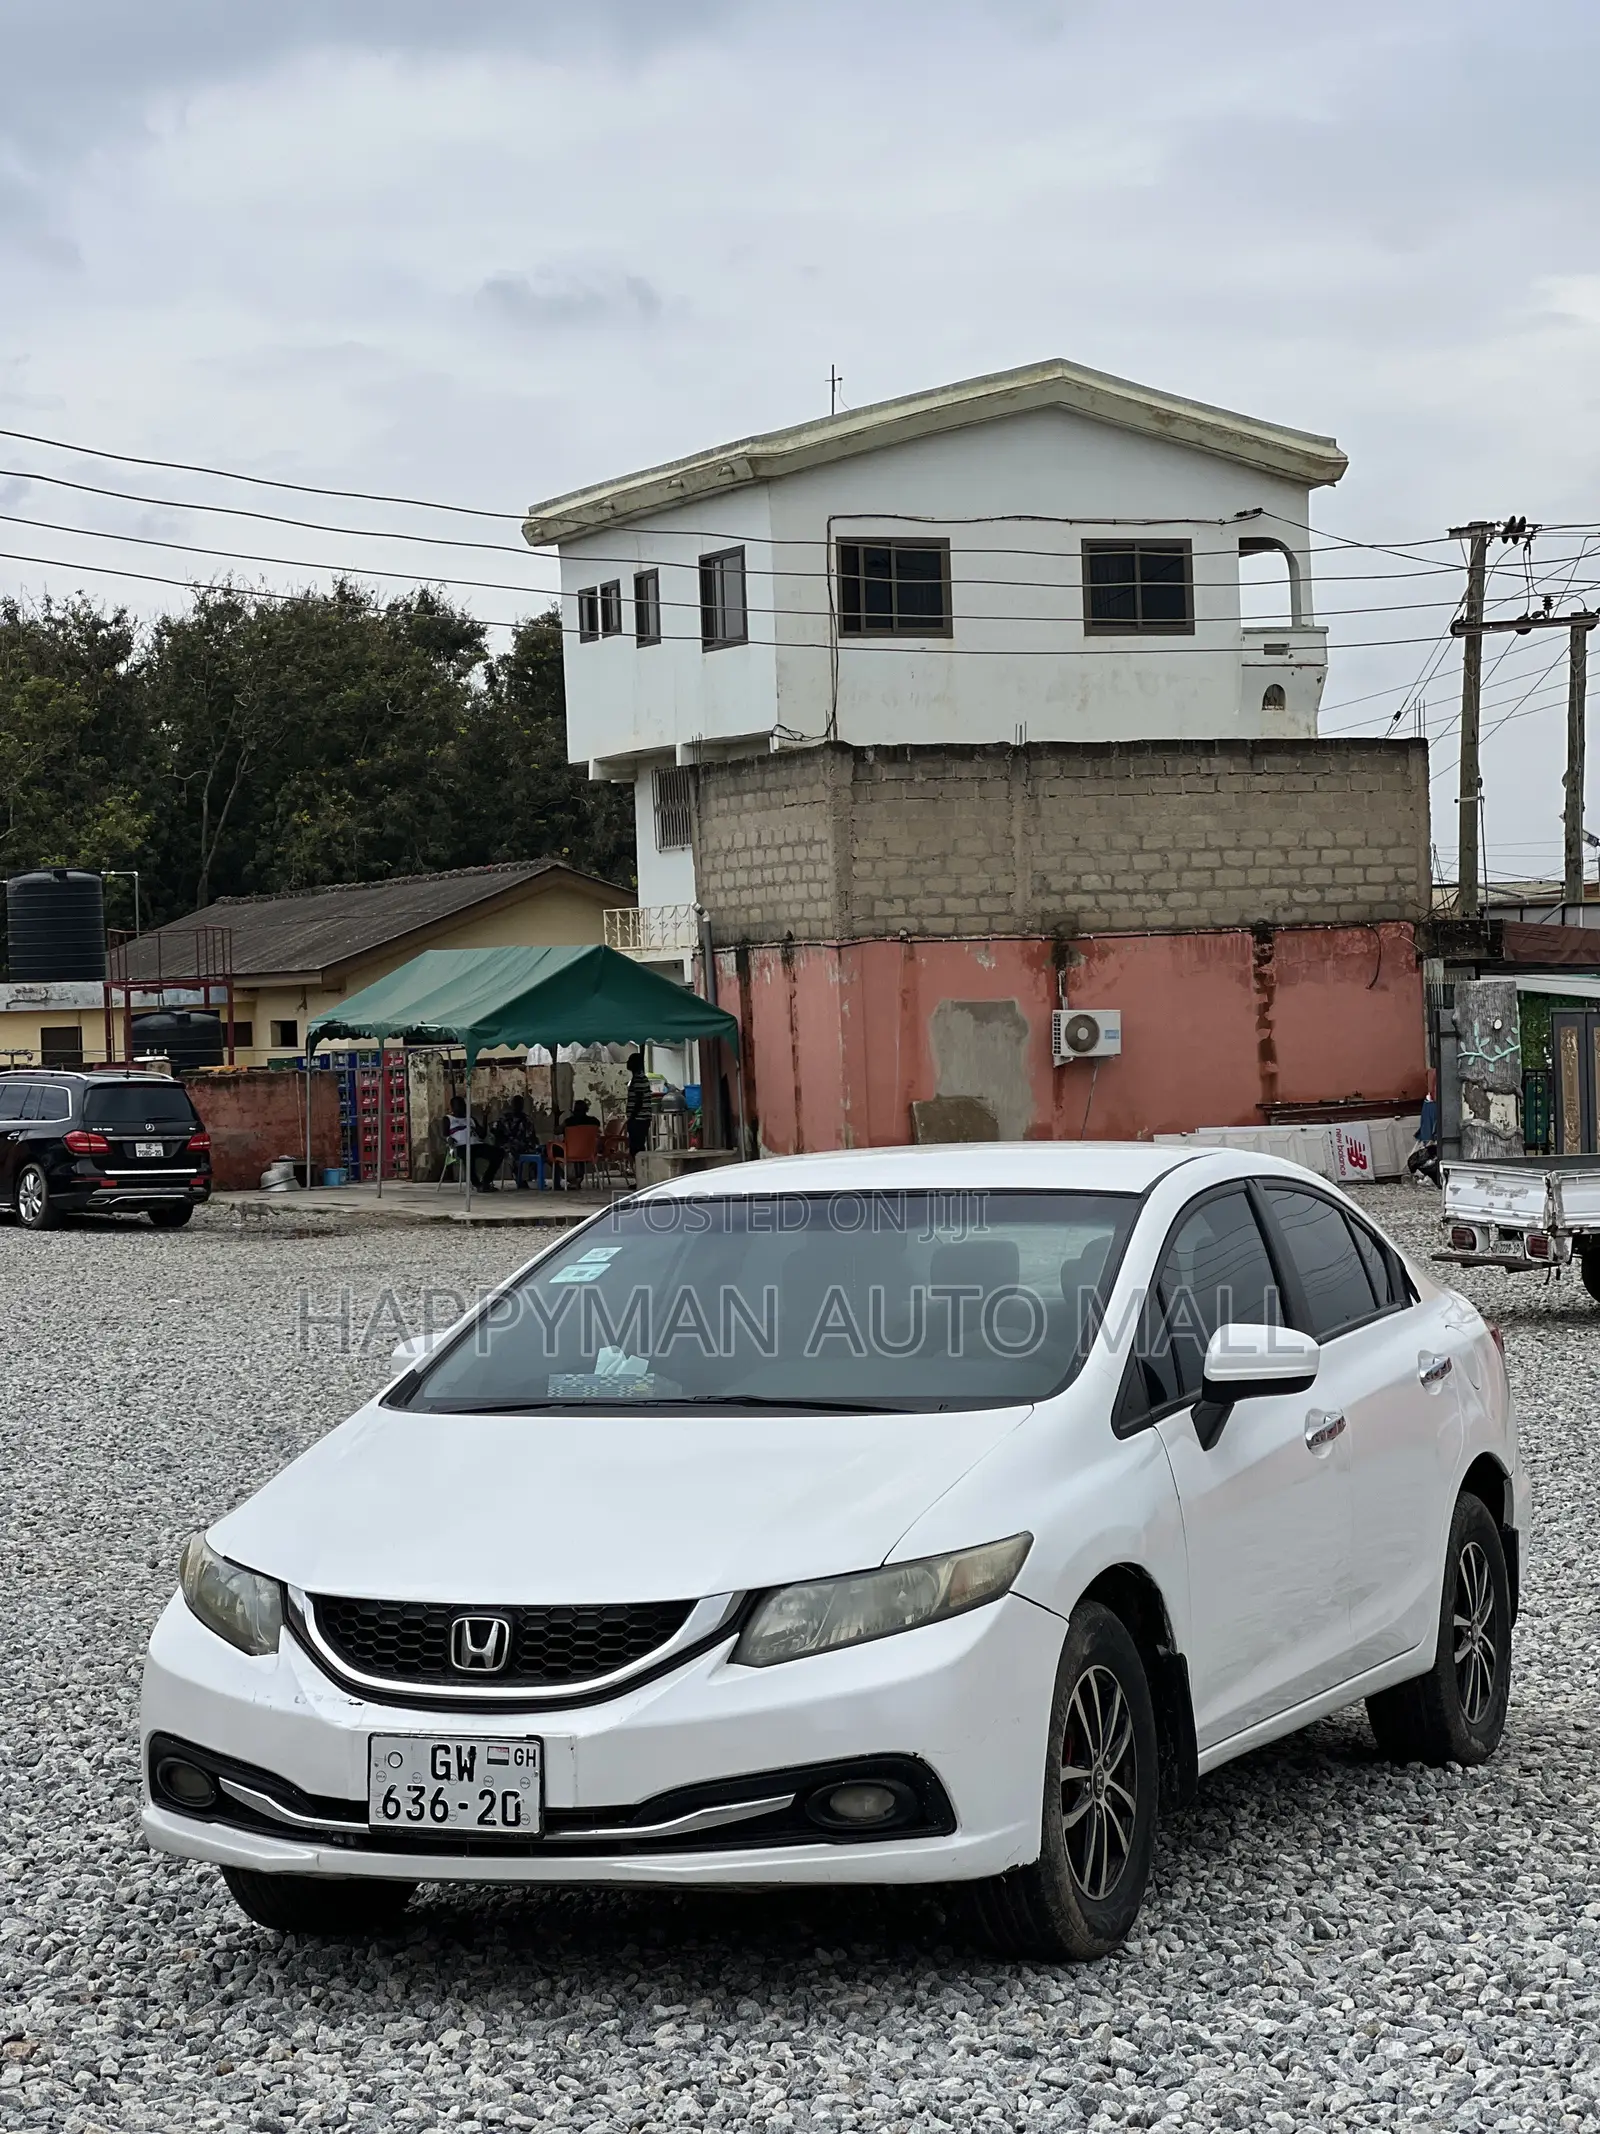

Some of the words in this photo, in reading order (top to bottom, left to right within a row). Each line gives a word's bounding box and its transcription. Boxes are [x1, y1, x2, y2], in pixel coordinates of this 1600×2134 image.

[1337, 1145, 1346, 1176] balance
[431, 1743, 477, 1782] GW
[513, 1748, 537, 1768] GH
[382, 1784, 522, 1827] 636-20
